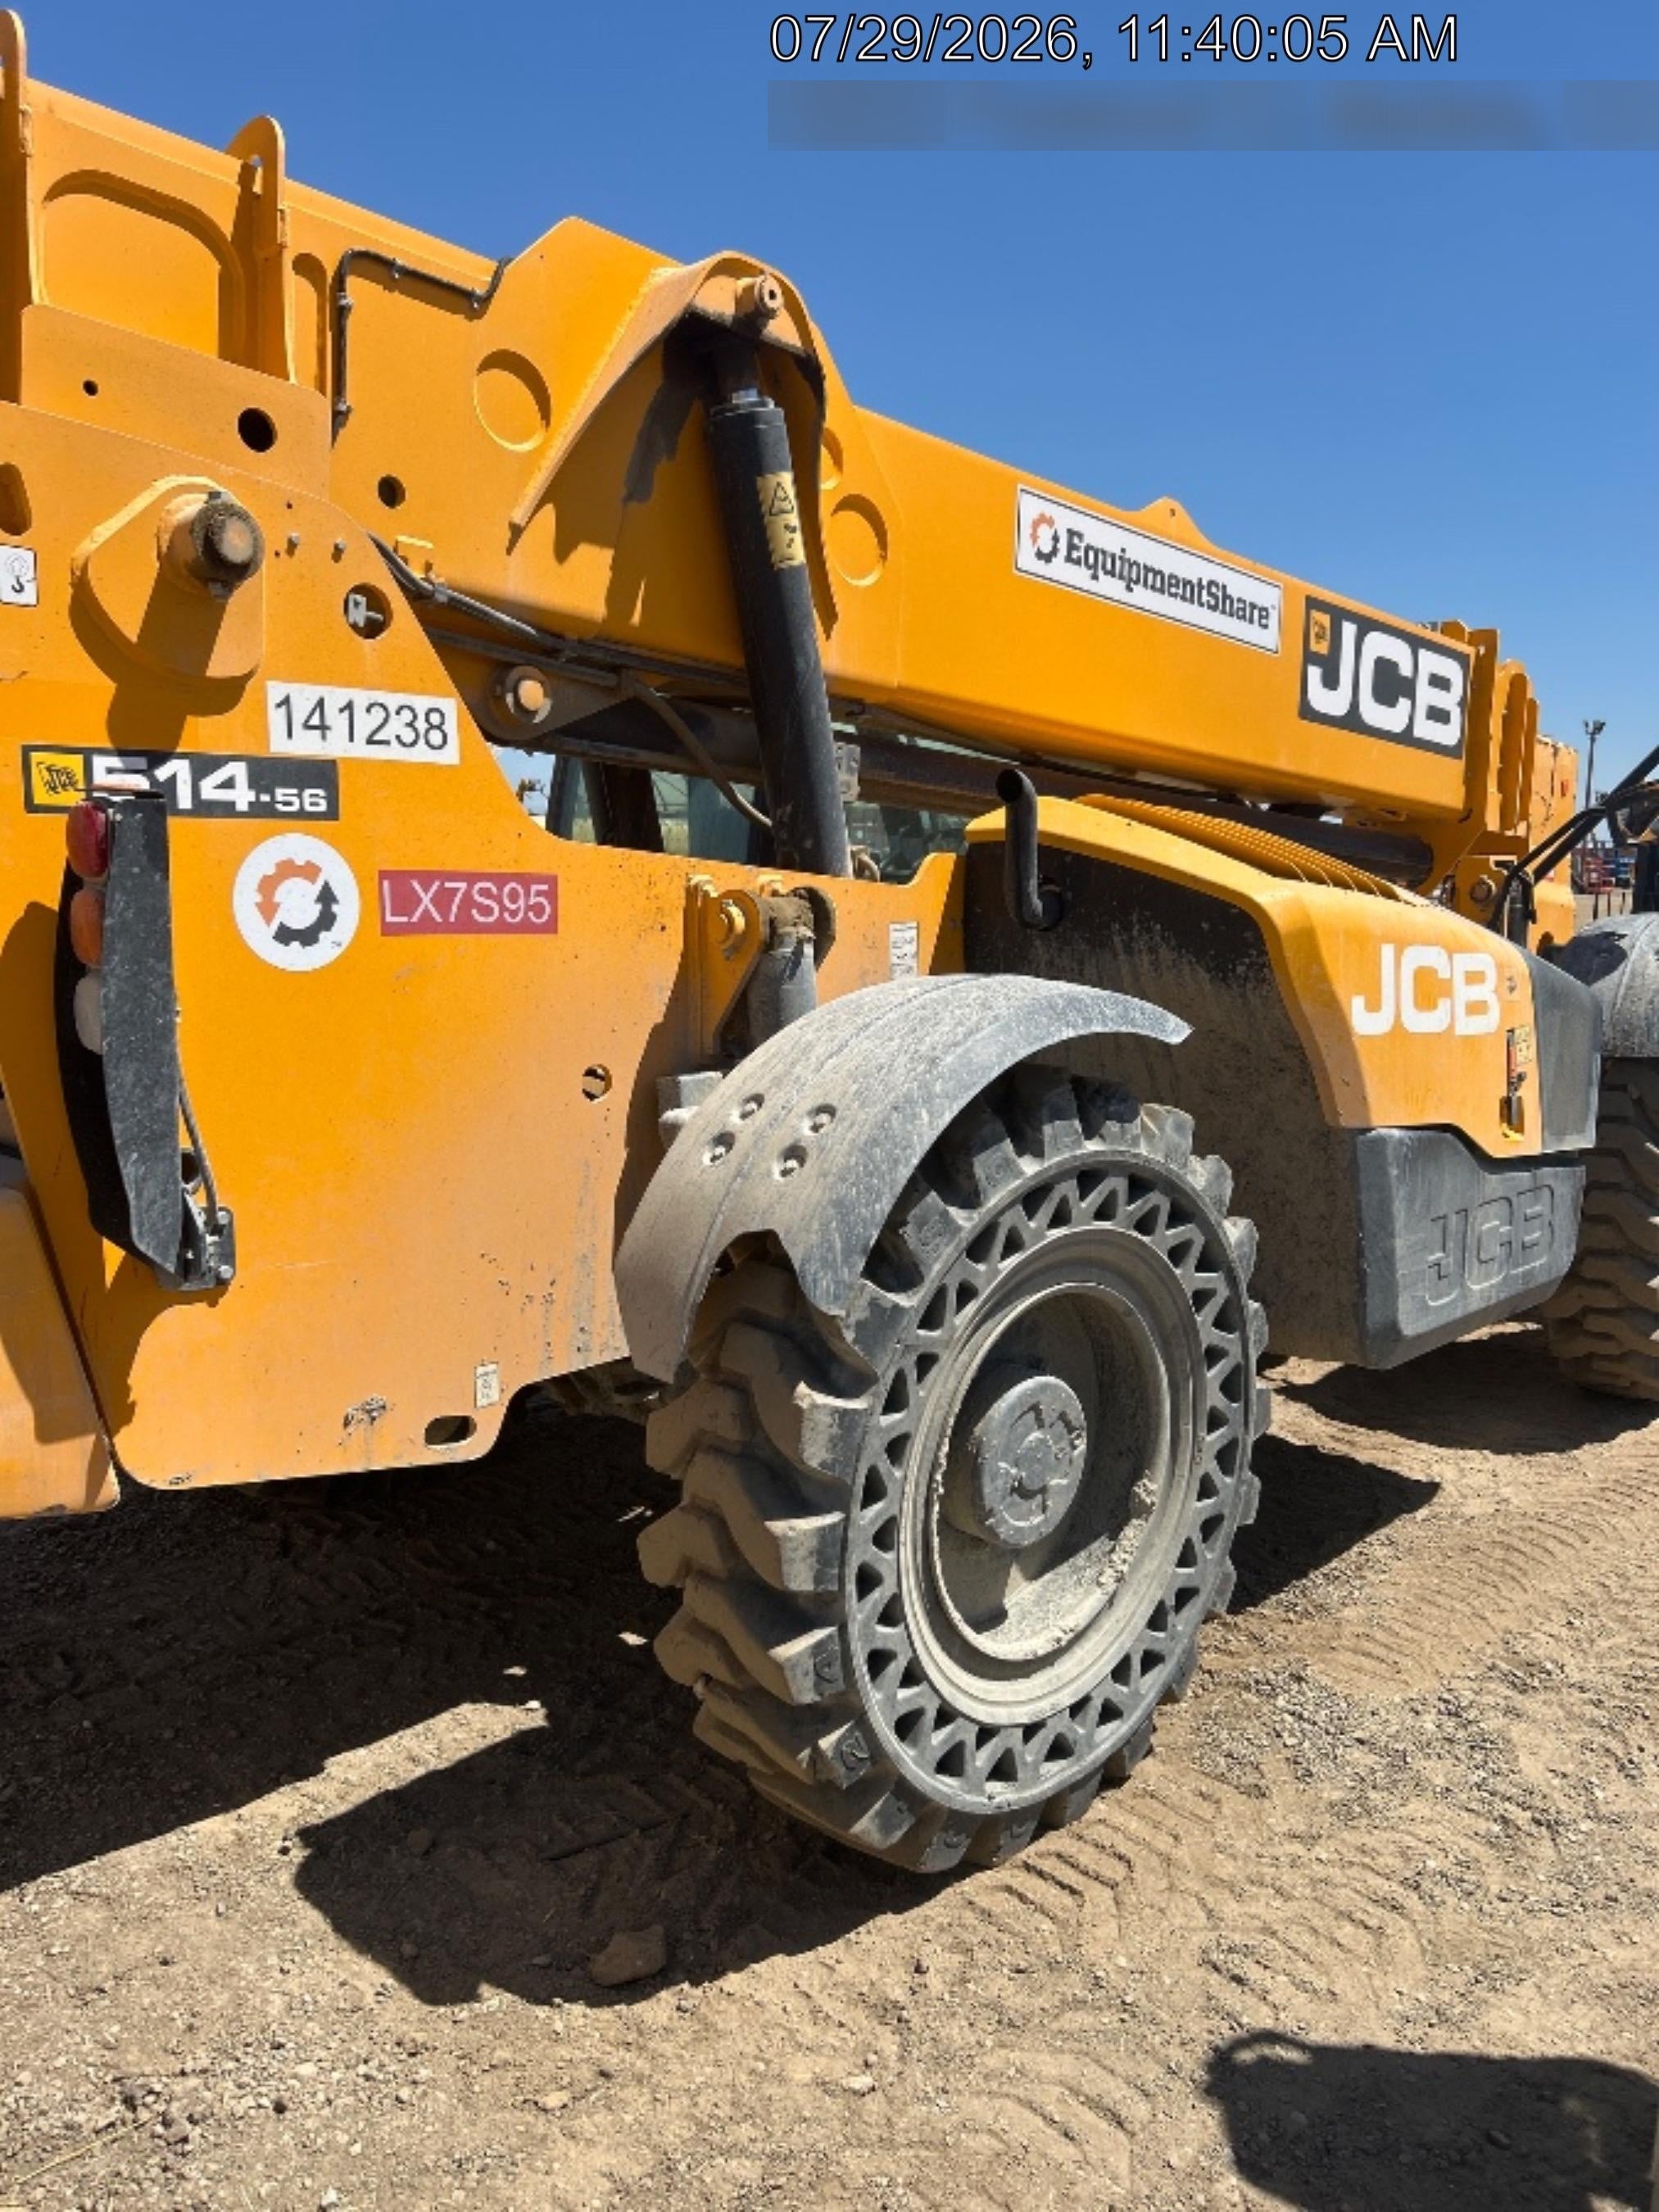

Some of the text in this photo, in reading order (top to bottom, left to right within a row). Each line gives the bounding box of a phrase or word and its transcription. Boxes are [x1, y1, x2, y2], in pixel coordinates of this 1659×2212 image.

[1064, 528, 1271, 630] EquipmentShare
[274, 693, 448, 750] 141238
[1307, 620, 1464, 747] JCB
[382, 879, 551, 923] LX7S95
[1352, 943, 1501, 1036] JCB
[1426, 1184, 1555, 1307] JCB
